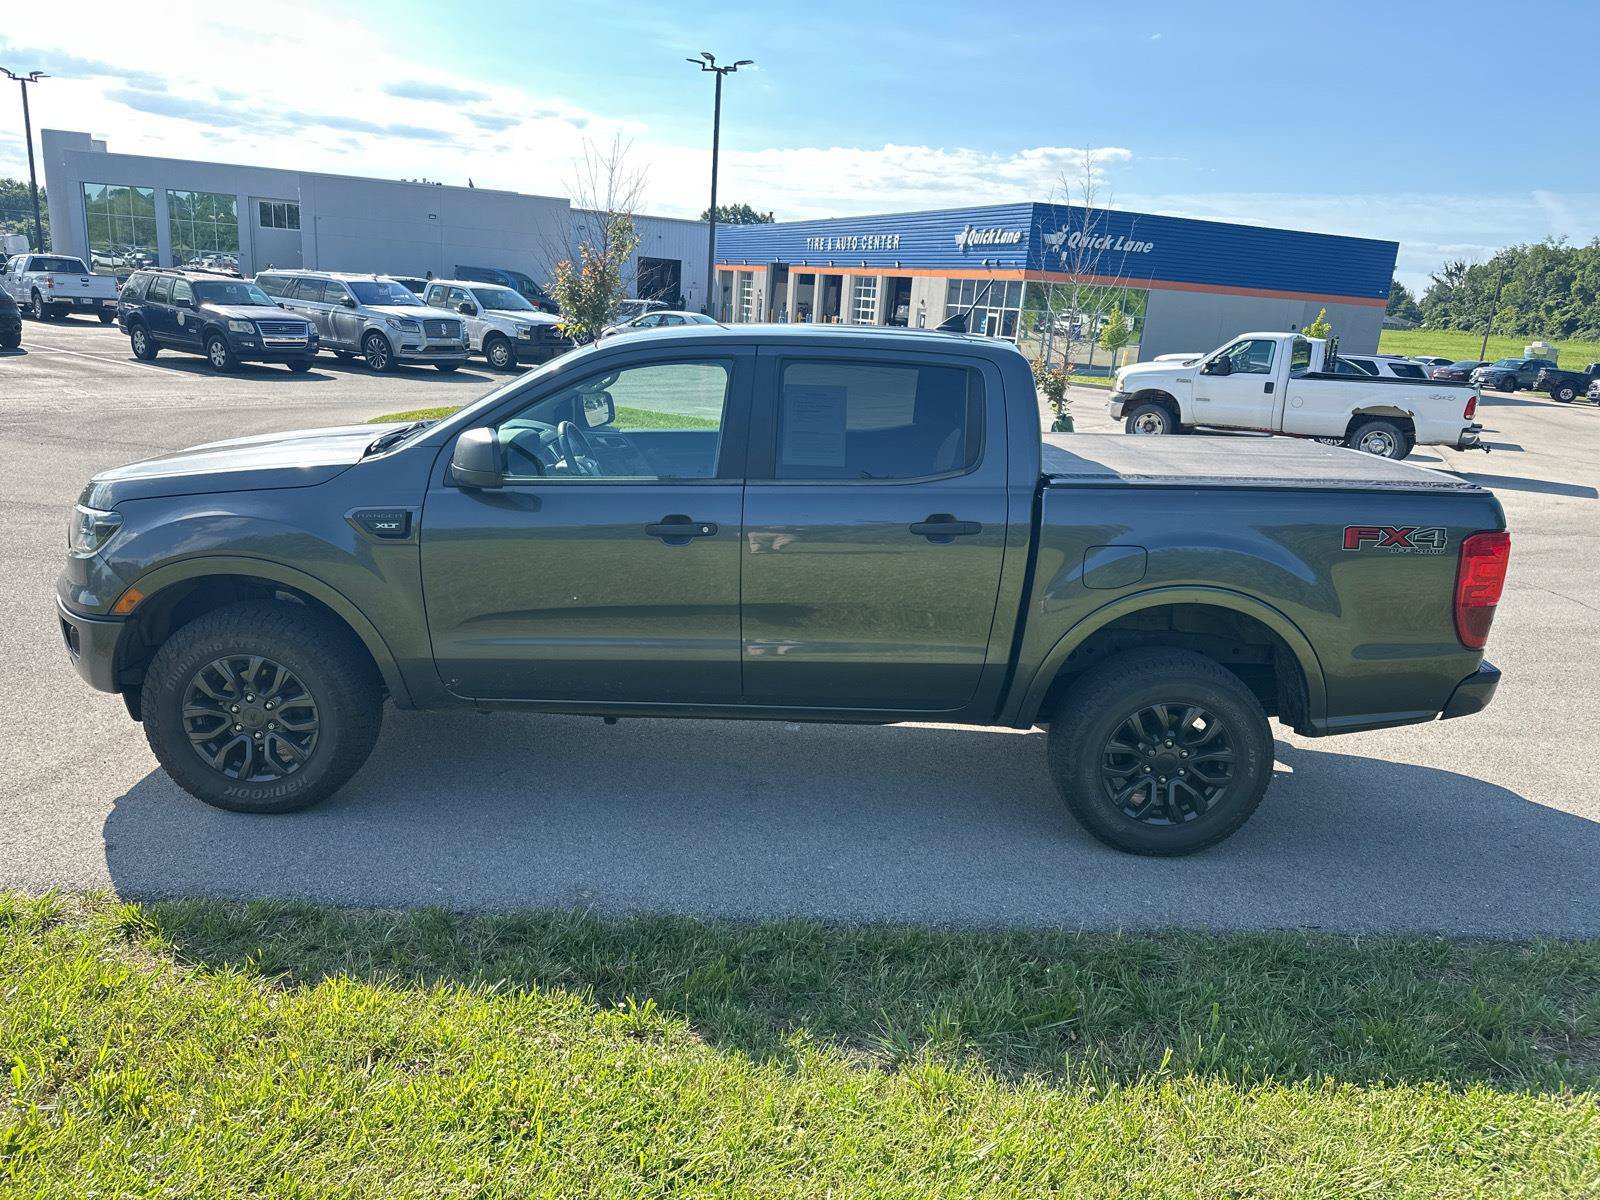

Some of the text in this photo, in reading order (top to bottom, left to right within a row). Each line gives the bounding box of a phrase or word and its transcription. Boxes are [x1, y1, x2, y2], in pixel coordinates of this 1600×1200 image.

[807, 238, 825, 251] TIRE
[836, 236, 858, 250] AUTO
[862, 234, 900, 249] CENTER
[967, 228, 1021, 246] Quick Lane
[1067, 231, 1154, 254] Quick Lane
[1341, 525, 1447, 551] FX4
